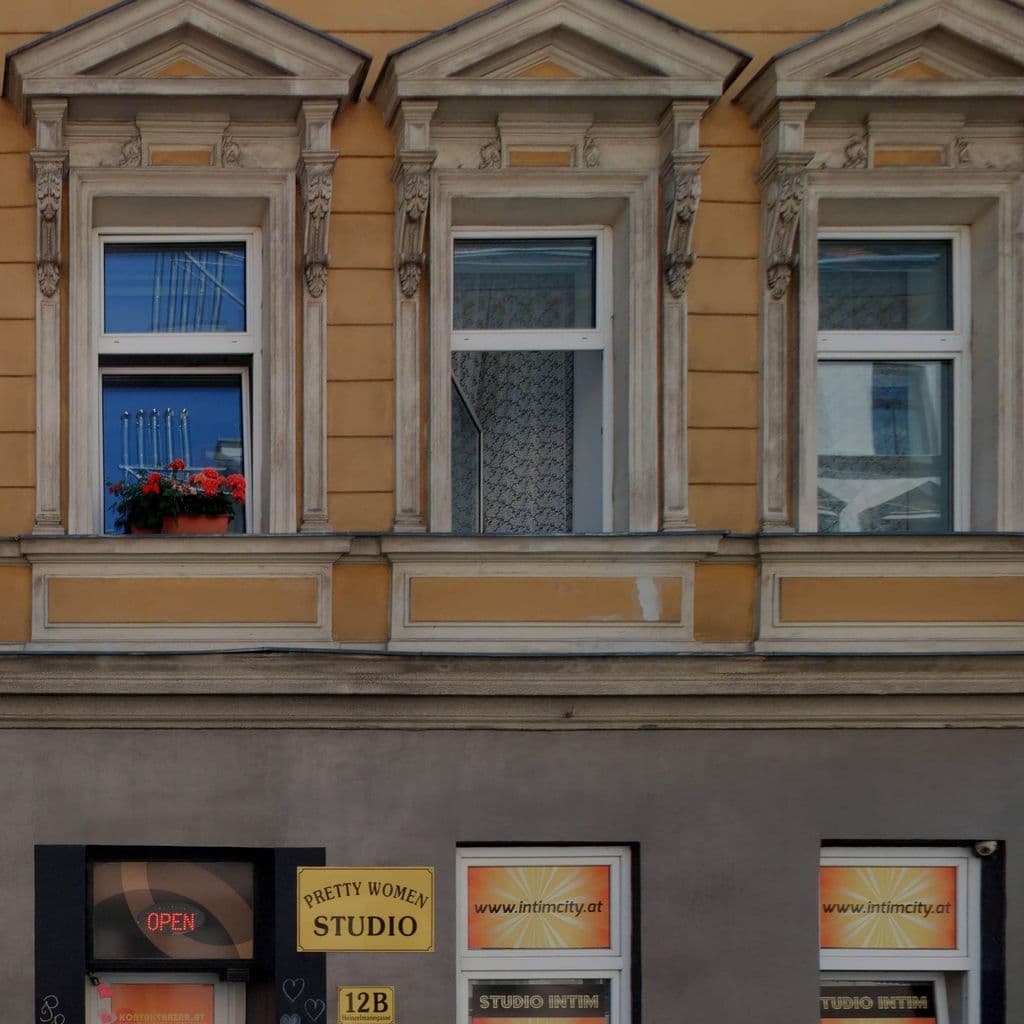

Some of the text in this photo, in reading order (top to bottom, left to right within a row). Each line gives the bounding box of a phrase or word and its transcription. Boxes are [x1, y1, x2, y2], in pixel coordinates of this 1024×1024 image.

[304, 881, 429, 909] PRETTY WOMEN
[474, 900, 604, 917] www.intimcity.at
[822, 900, 952, 918] www.intimcity.at
[146, 911, 195, 932] OPEN
[313, 915, 418, 937] STUDIO
[345, 991, 389, 1013] 12B
[479, 994, 599, 1009] STUDIO INTIM
[877, 995, 928, 1010] INTIM
